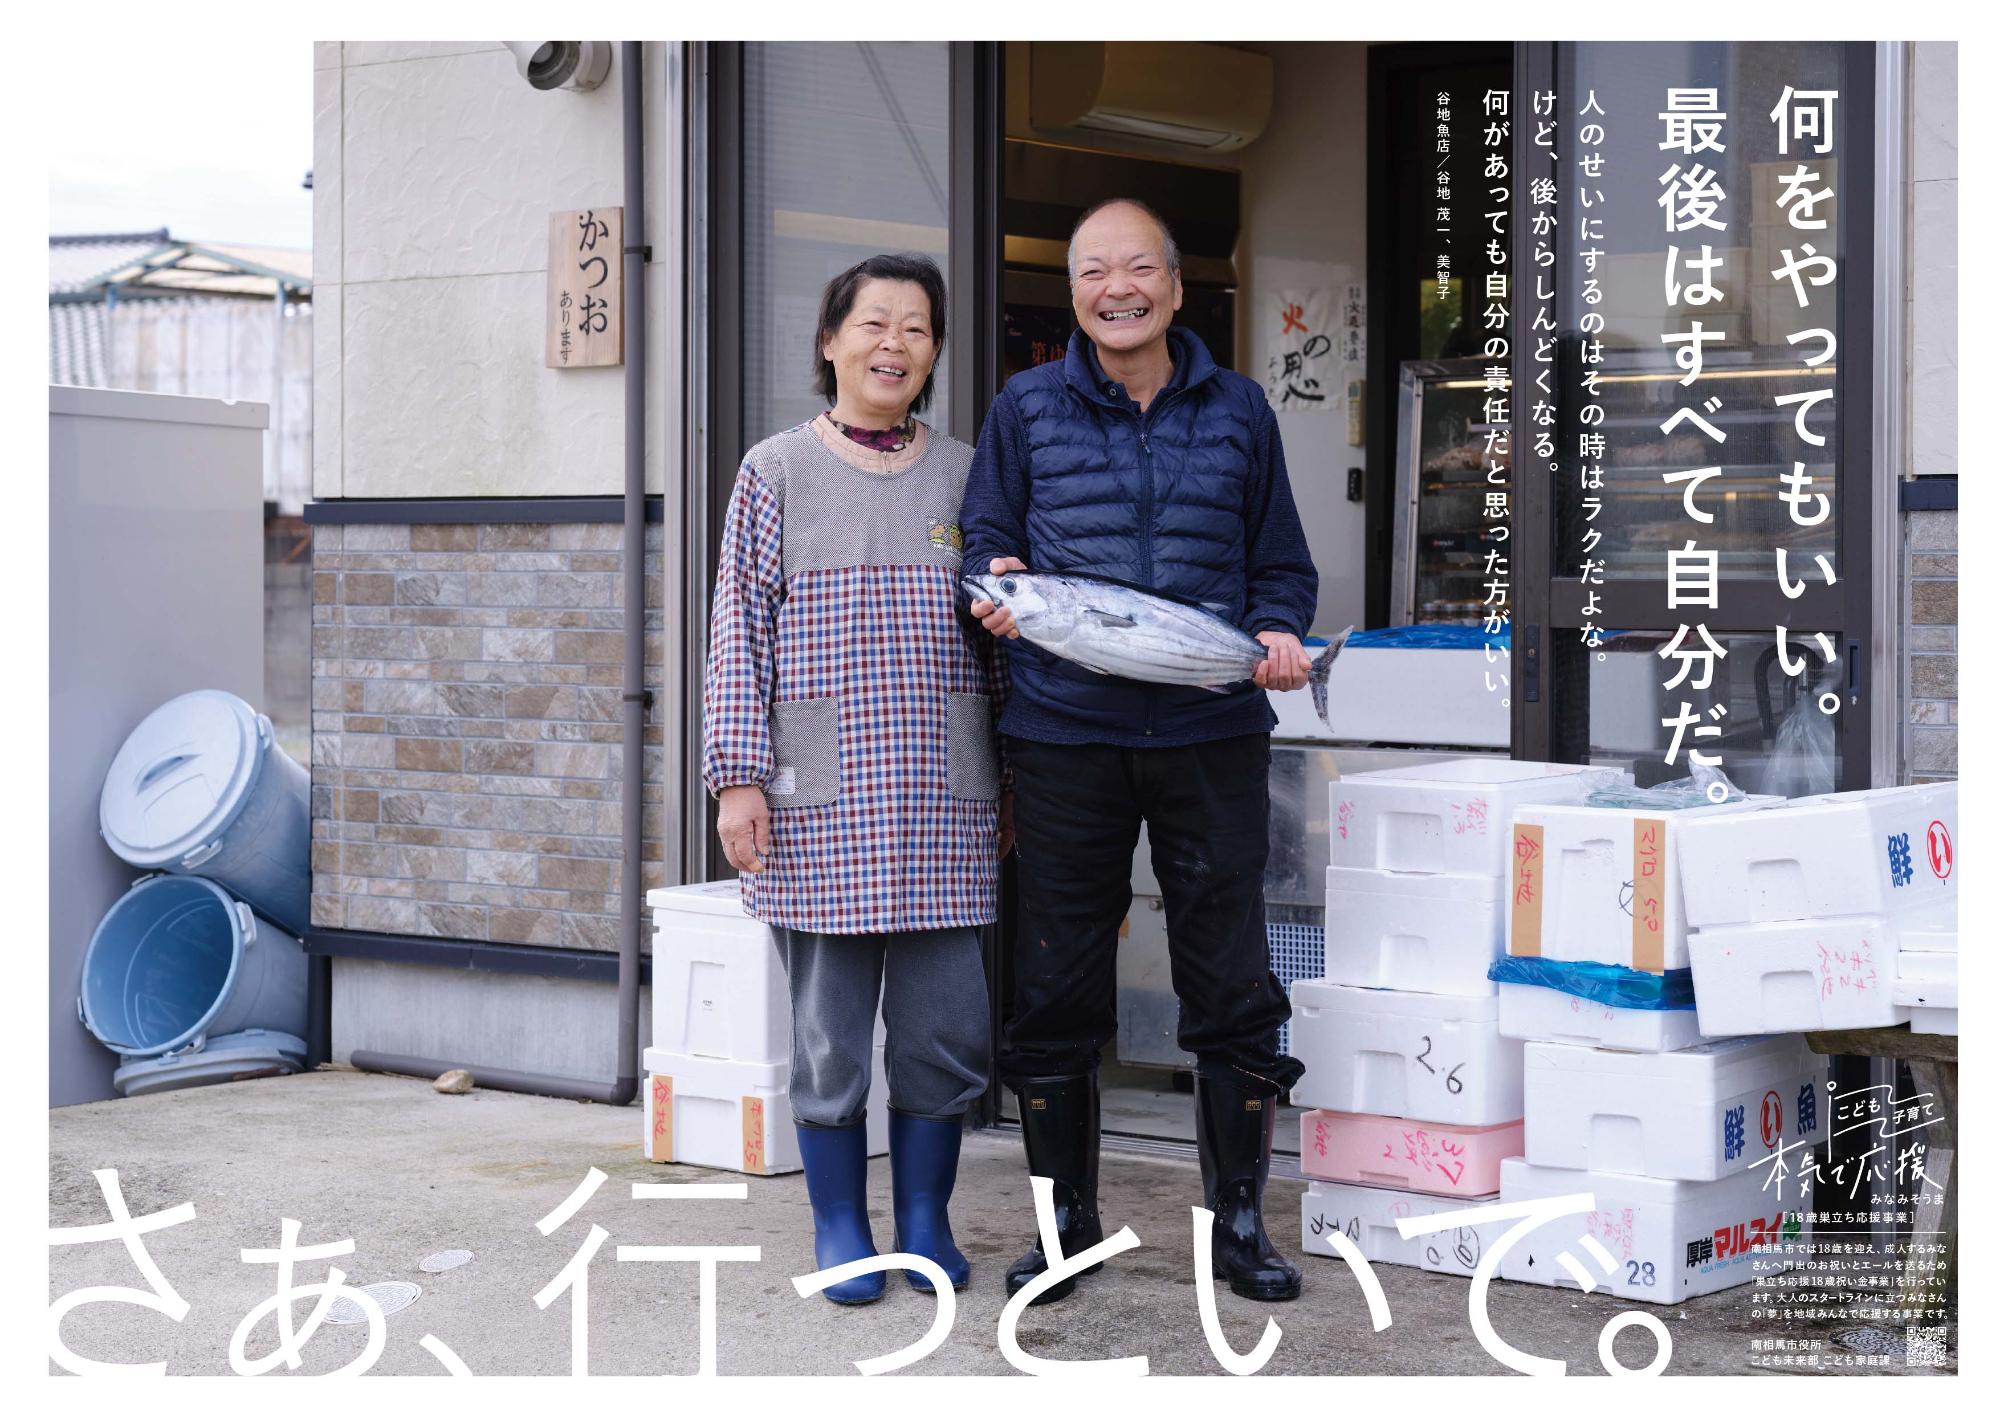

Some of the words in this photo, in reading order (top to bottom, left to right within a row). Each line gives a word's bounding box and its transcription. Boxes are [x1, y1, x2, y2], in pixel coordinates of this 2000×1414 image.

[579, 210, 609, 336] かつお
[559, 290, 573, 365] あります
[1281, 303, 1326, 404] 火の用心
[1516, 833, 1540, 906] 谷地
[1887, 832, 1914, 889] 鮮
[1415, 1035, 1467, 1095] 2.6
[1723, 1104, 1746, 1163] 鮮
[1796, 1082, 1817, 1136] 魚
[1626, 1259, 1657, 1287] 28
[1686, 1237, 1713, 1269] 厚岸
[1713, 1211, 1784, 1261] マルスイ
